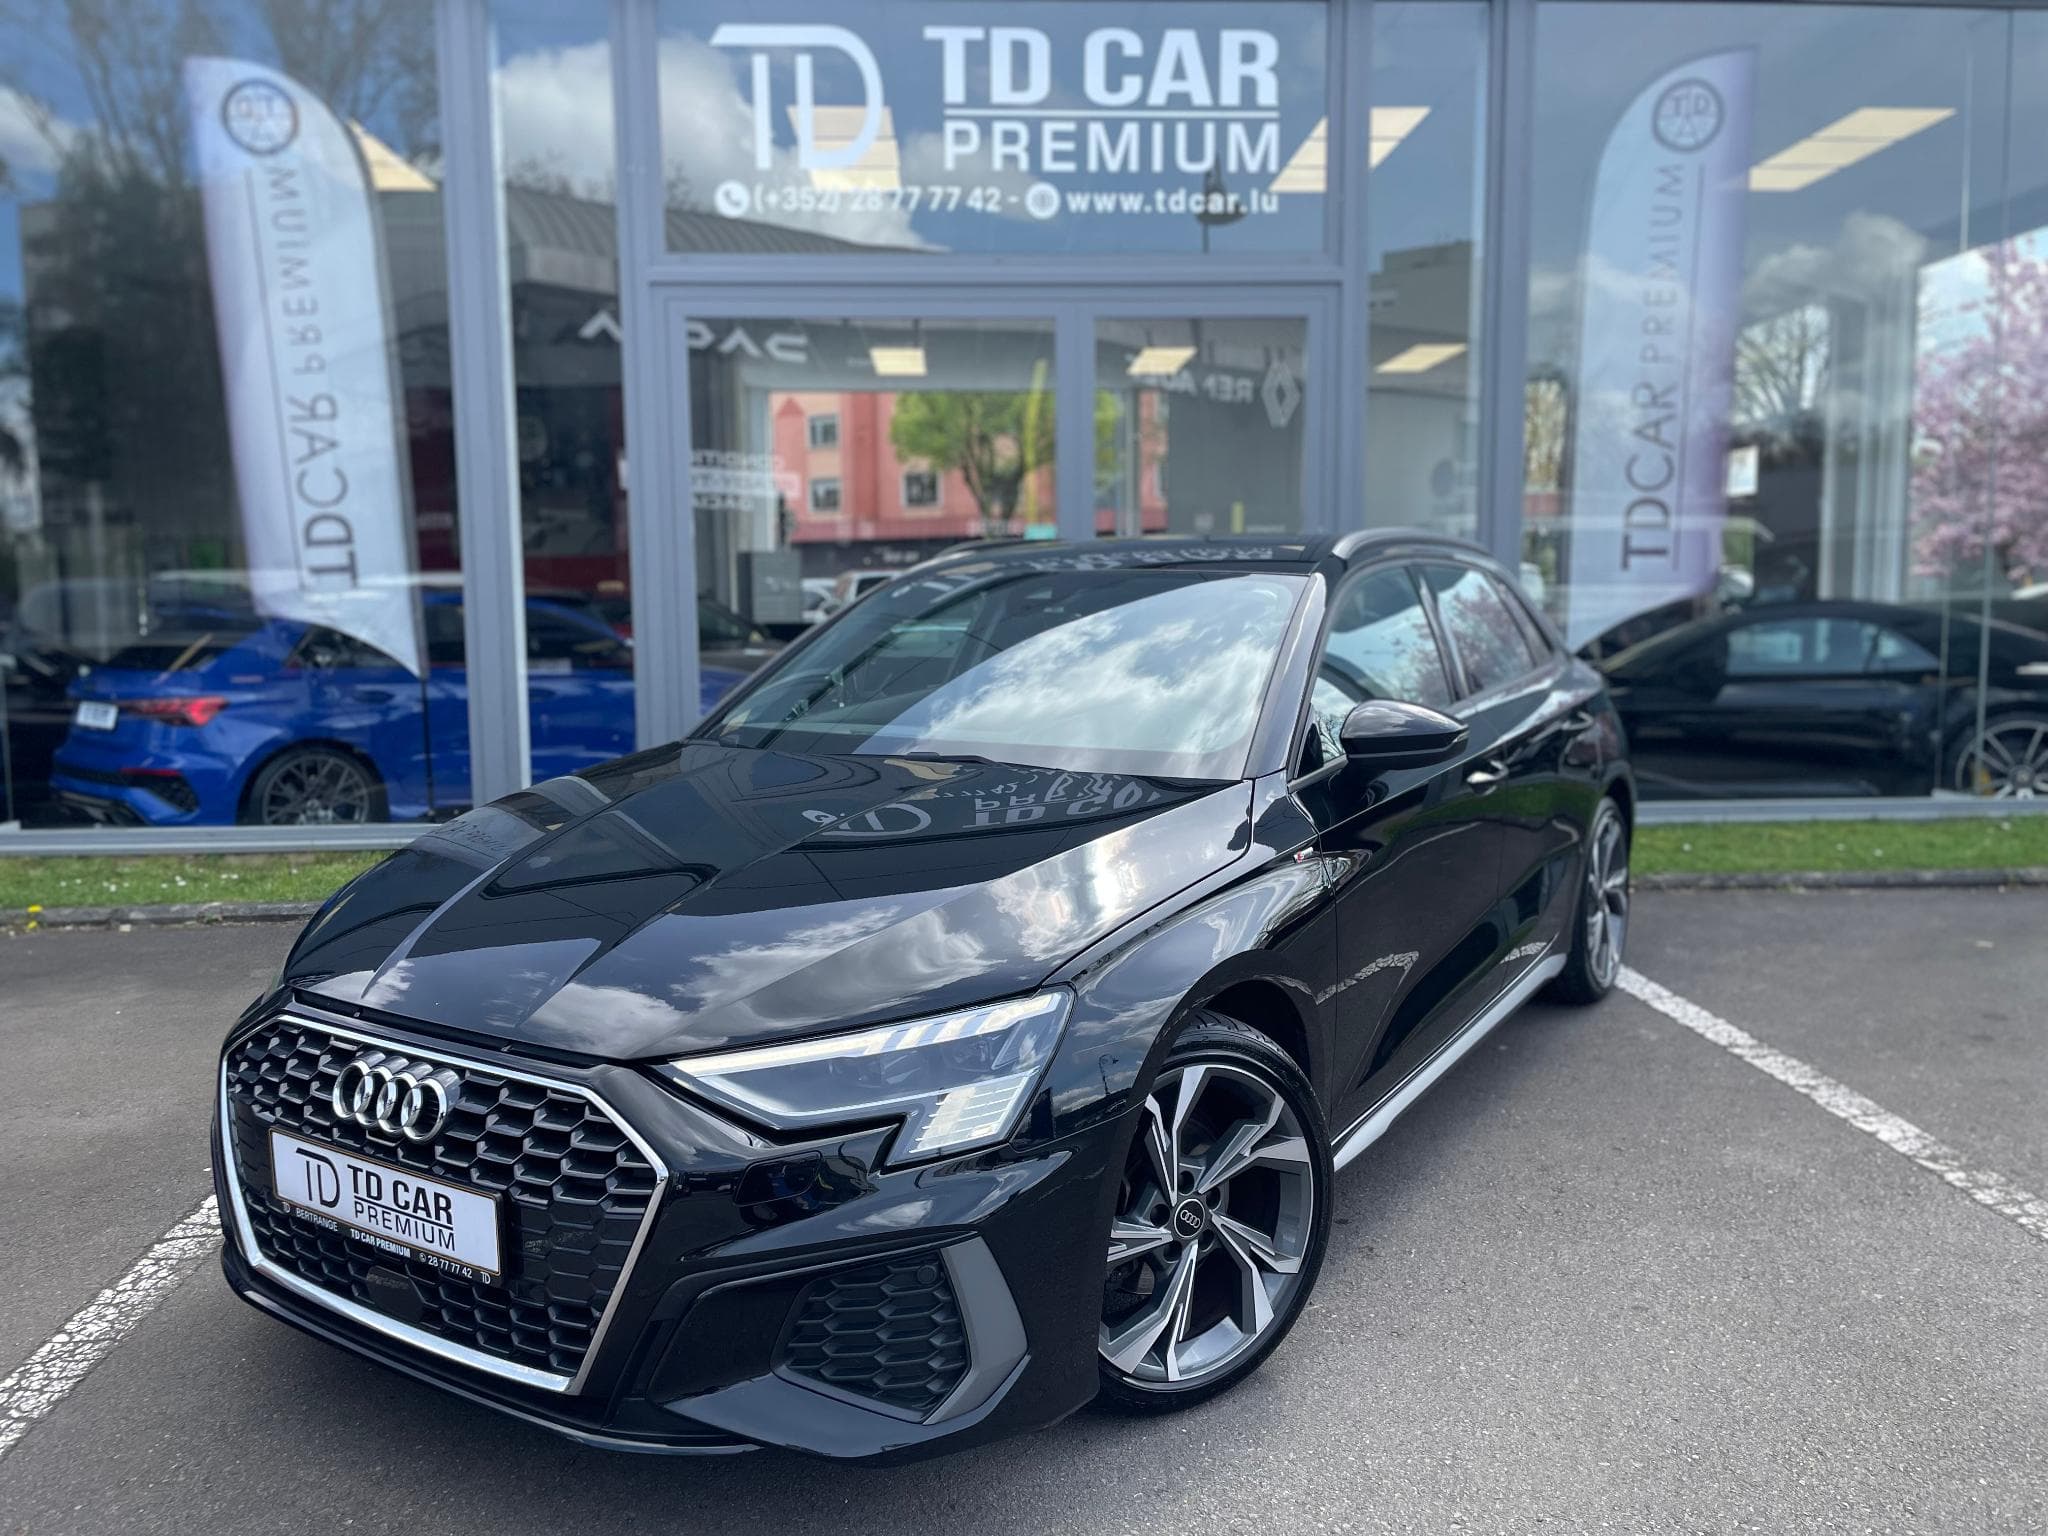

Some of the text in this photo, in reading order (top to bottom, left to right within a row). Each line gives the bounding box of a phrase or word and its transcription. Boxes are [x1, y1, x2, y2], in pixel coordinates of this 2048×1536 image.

[923, 25, 1279, 108] TD CAR
[943, 121, 1279, 174] PREMIUM
[927, 186, 962, 213] 77
[966, 186, 1001, 213] 42
[1066, 183, 1280, 214] www.tdcar.lu
[1621, 164, 1684, 571] TDCAR PREMIUM
[347, 1163, 454, 1226] TD CAR
[349, 1228, 411, 1259] TD CAR PREMIUM
[354, 1201, 456, 1252] PREMIUM
[461, 1266, 473, 1279] 42
